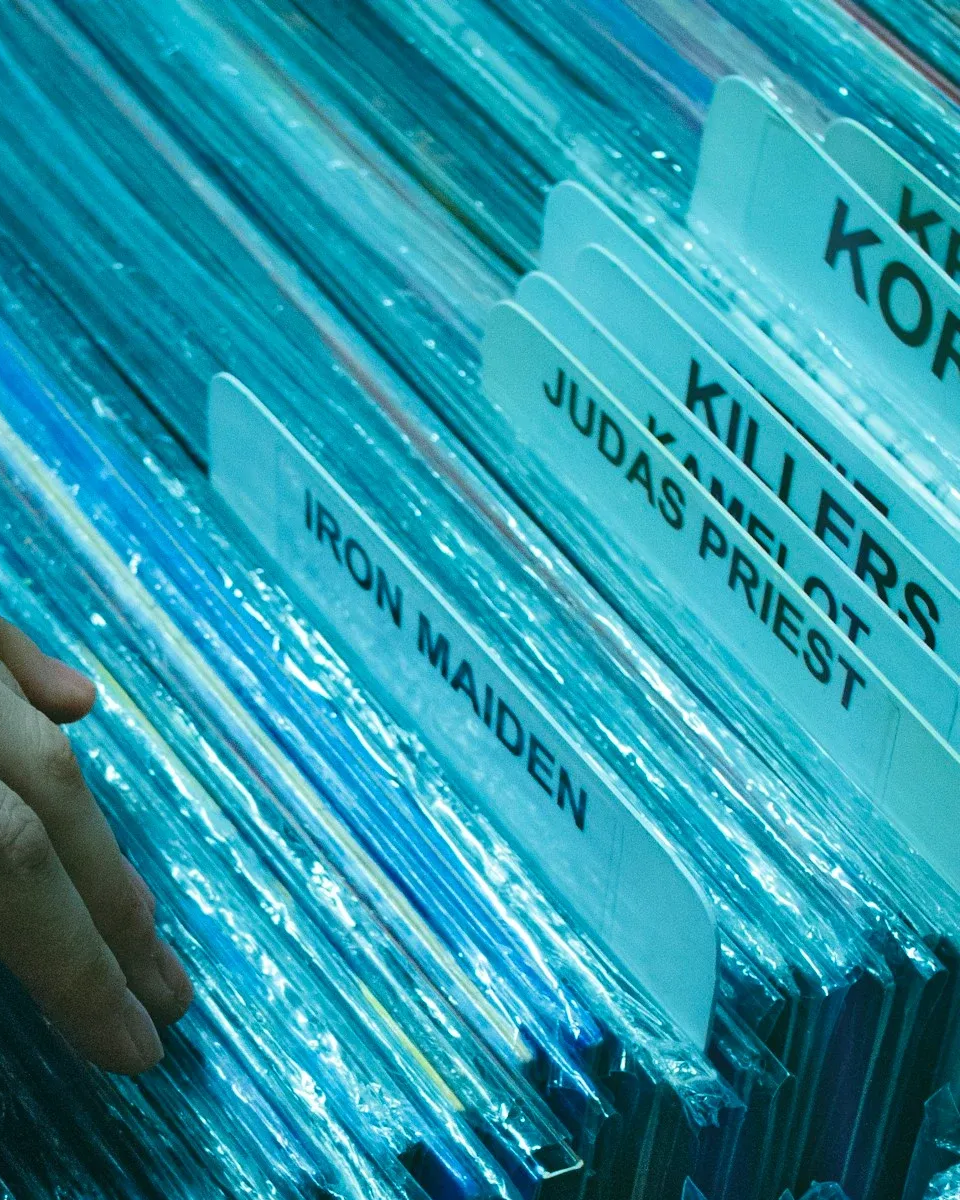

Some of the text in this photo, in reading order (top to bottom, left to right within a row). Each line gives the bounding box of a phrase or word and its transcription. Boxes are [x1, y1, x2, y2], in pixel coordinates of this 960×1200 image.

[305, 489, 587, 831] IRON MAIDEN
[543, 368, 685, 530] JUDAS
[698, 516, 866, 710] PRIEST
[685, 358, 940, 653] KILLERS
